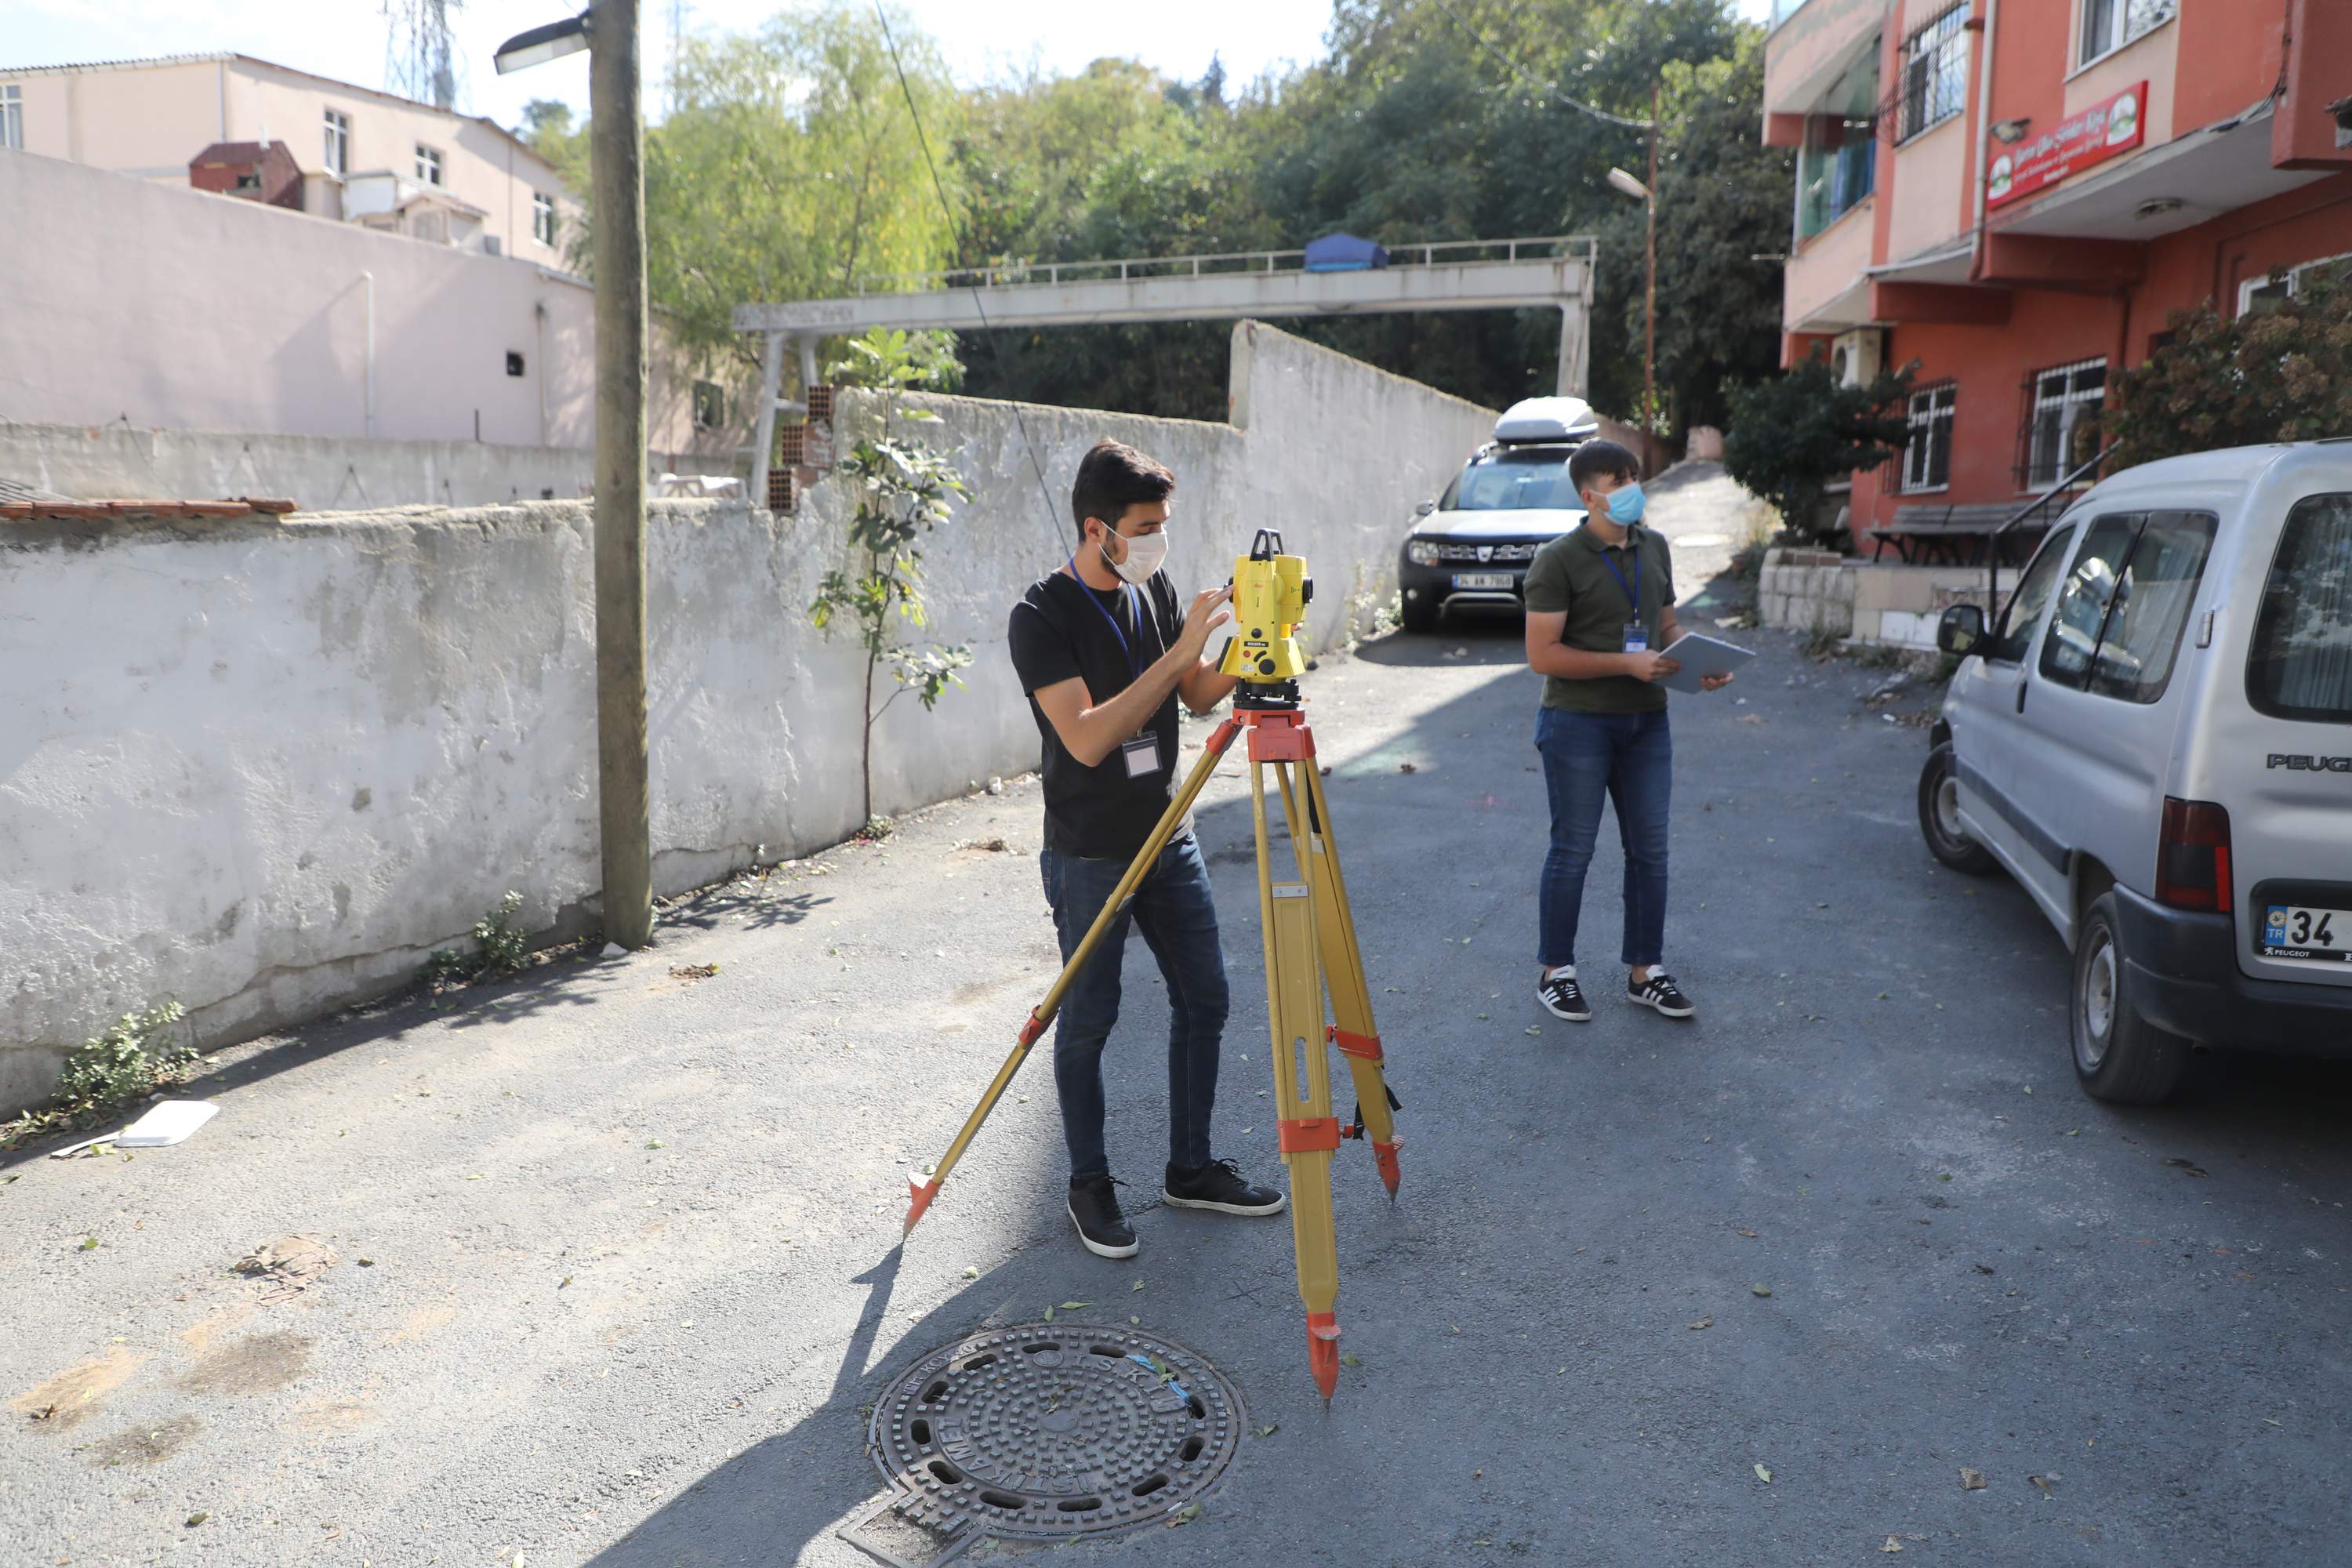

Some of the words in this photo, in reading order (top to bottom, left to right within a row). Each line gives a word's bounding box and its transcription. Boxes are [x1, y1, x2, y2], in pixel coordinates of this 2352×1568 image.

[2267, 753, 2352, 773] PEUG
[2267, 928, 2284, 939] TR
[2291, 910, 2334, 947] 34
[2274, 949, 2310, 958] PEUGEOT
